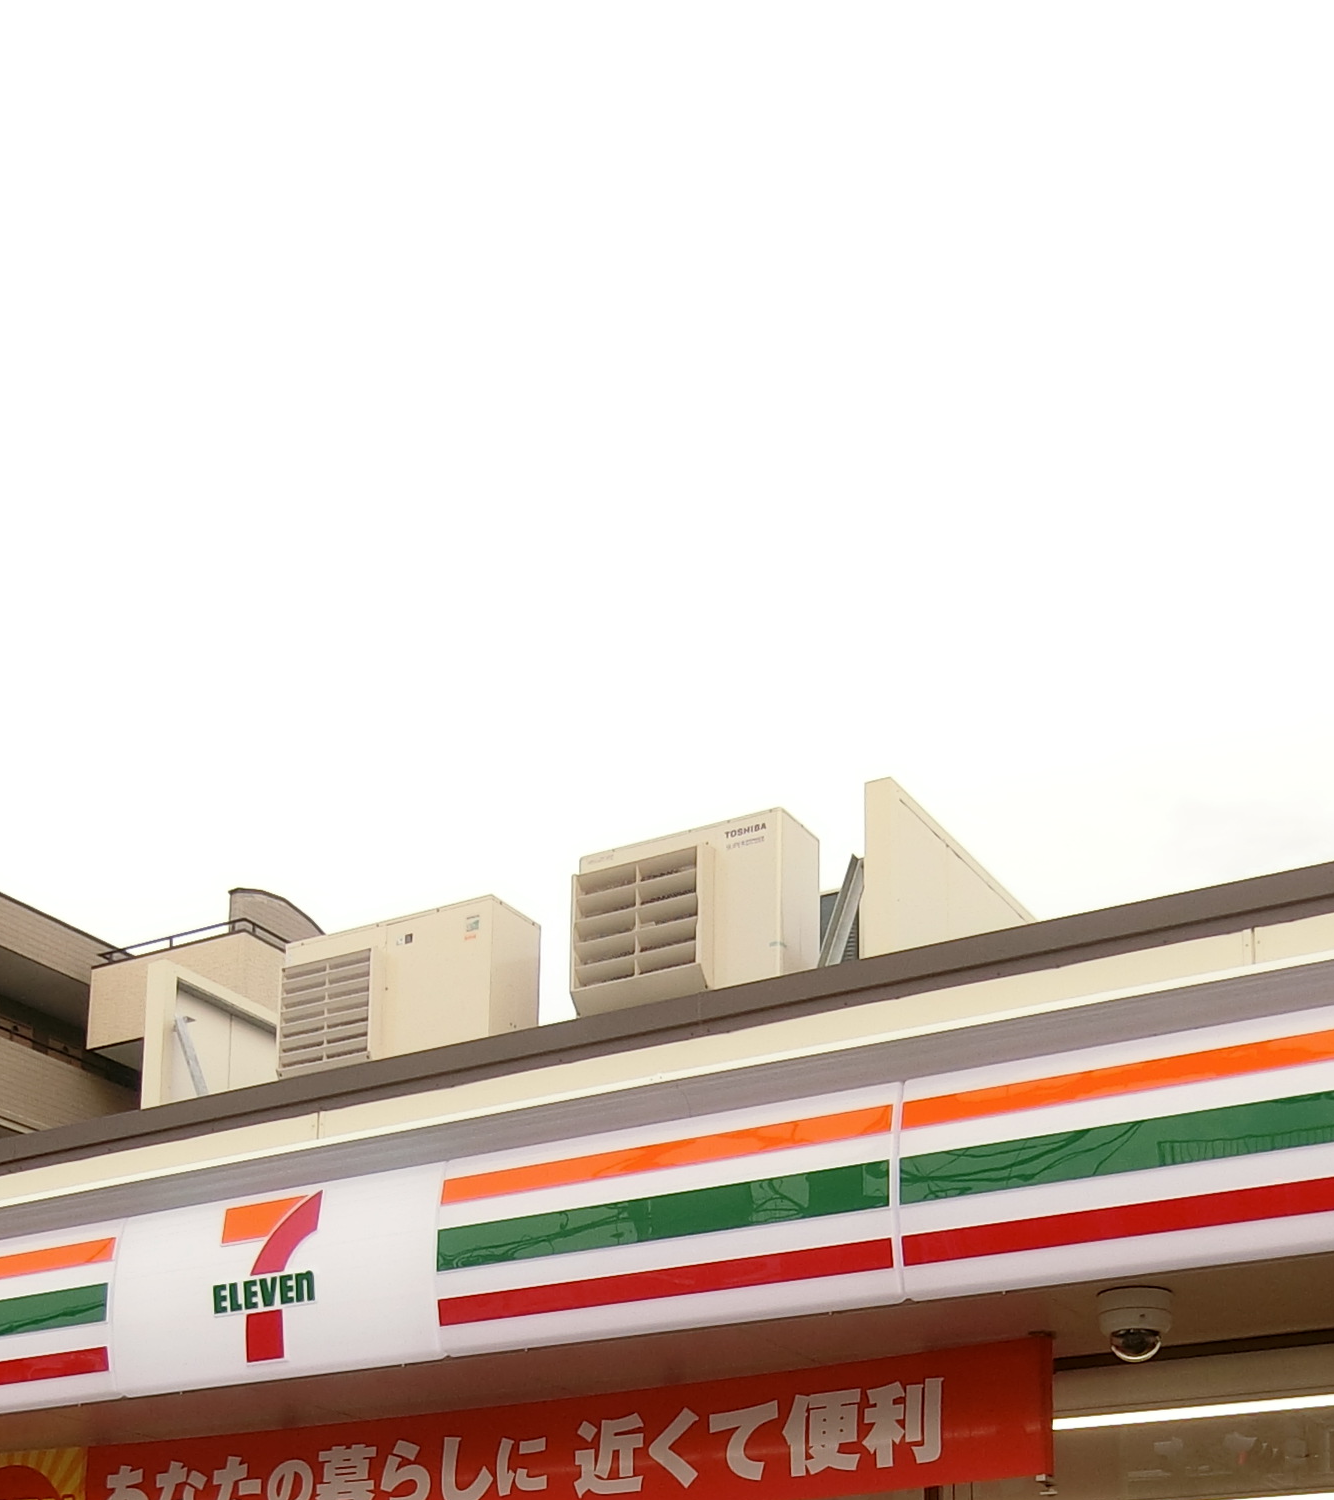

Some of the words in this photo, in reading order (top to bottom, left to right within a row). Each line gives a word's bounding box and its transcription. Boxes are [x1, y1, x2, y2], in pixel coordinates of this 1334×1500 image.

[724, 823, 767, 839] TOSHIBA
[573, 1377, 944, 1499] 近くて便利
